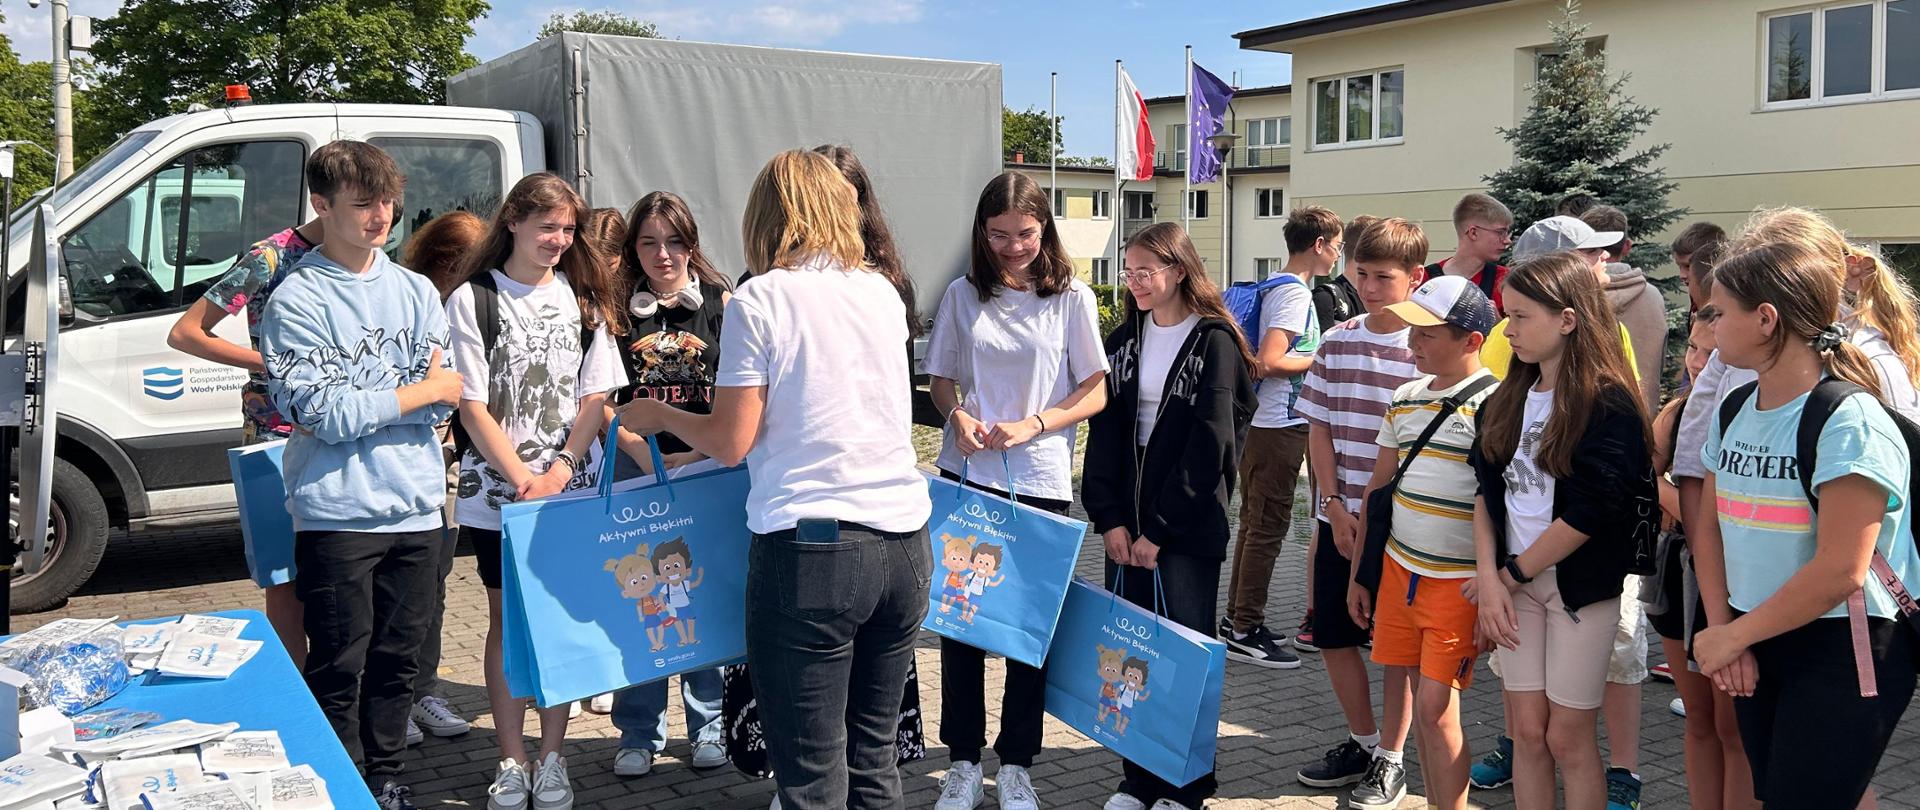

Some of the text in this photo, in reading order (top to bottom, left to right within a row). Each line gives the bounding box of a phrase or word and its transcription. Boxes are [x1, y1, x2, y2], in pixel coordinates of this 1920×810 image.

[189, 367, 234, 375] Państwowe
[190, 374, 247, 384] Gospodarstwo
[190, 385, 215, 394] Wody
[633, 385, 712, 404] QUEEN
[1717, 448, 1799, 480] OREVER
[599, 515, 694, 543] Aktywni Błękitni
[947, 512, 1017, 543] Aktywni Błękitni
[1101, 624, 1160, 659] Aktywni Błękitni
